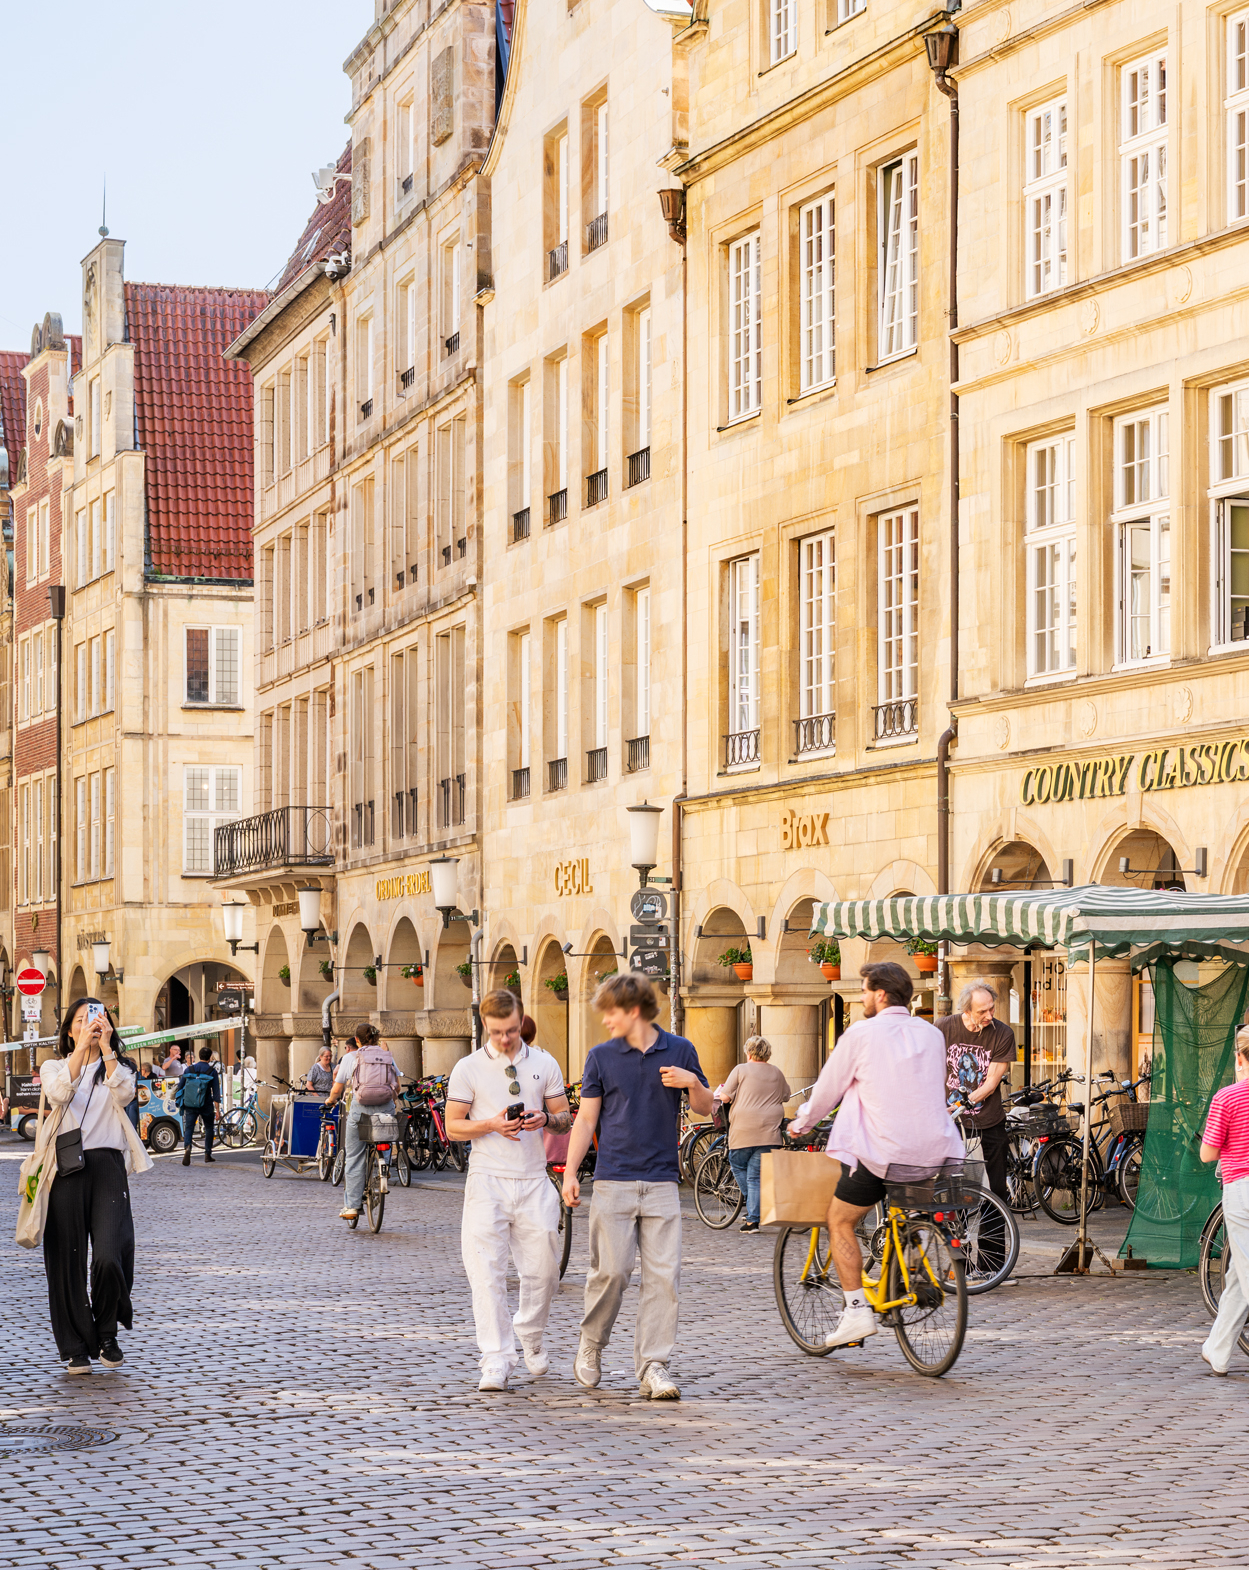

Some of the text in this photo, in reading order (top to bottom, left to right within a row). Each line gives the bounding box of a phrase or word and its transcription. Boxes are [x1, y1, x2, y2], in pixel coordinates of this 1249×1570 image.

[1020, 755, 1134, 806] COUNTRY
[779, 809, 830, 850] Brax
[375, 870, 432, 901] OEDING-ERDEL
[554, 857, 594, 897] CECIL
[127, 1037, 167, 1050] LEEZEN HEROES
